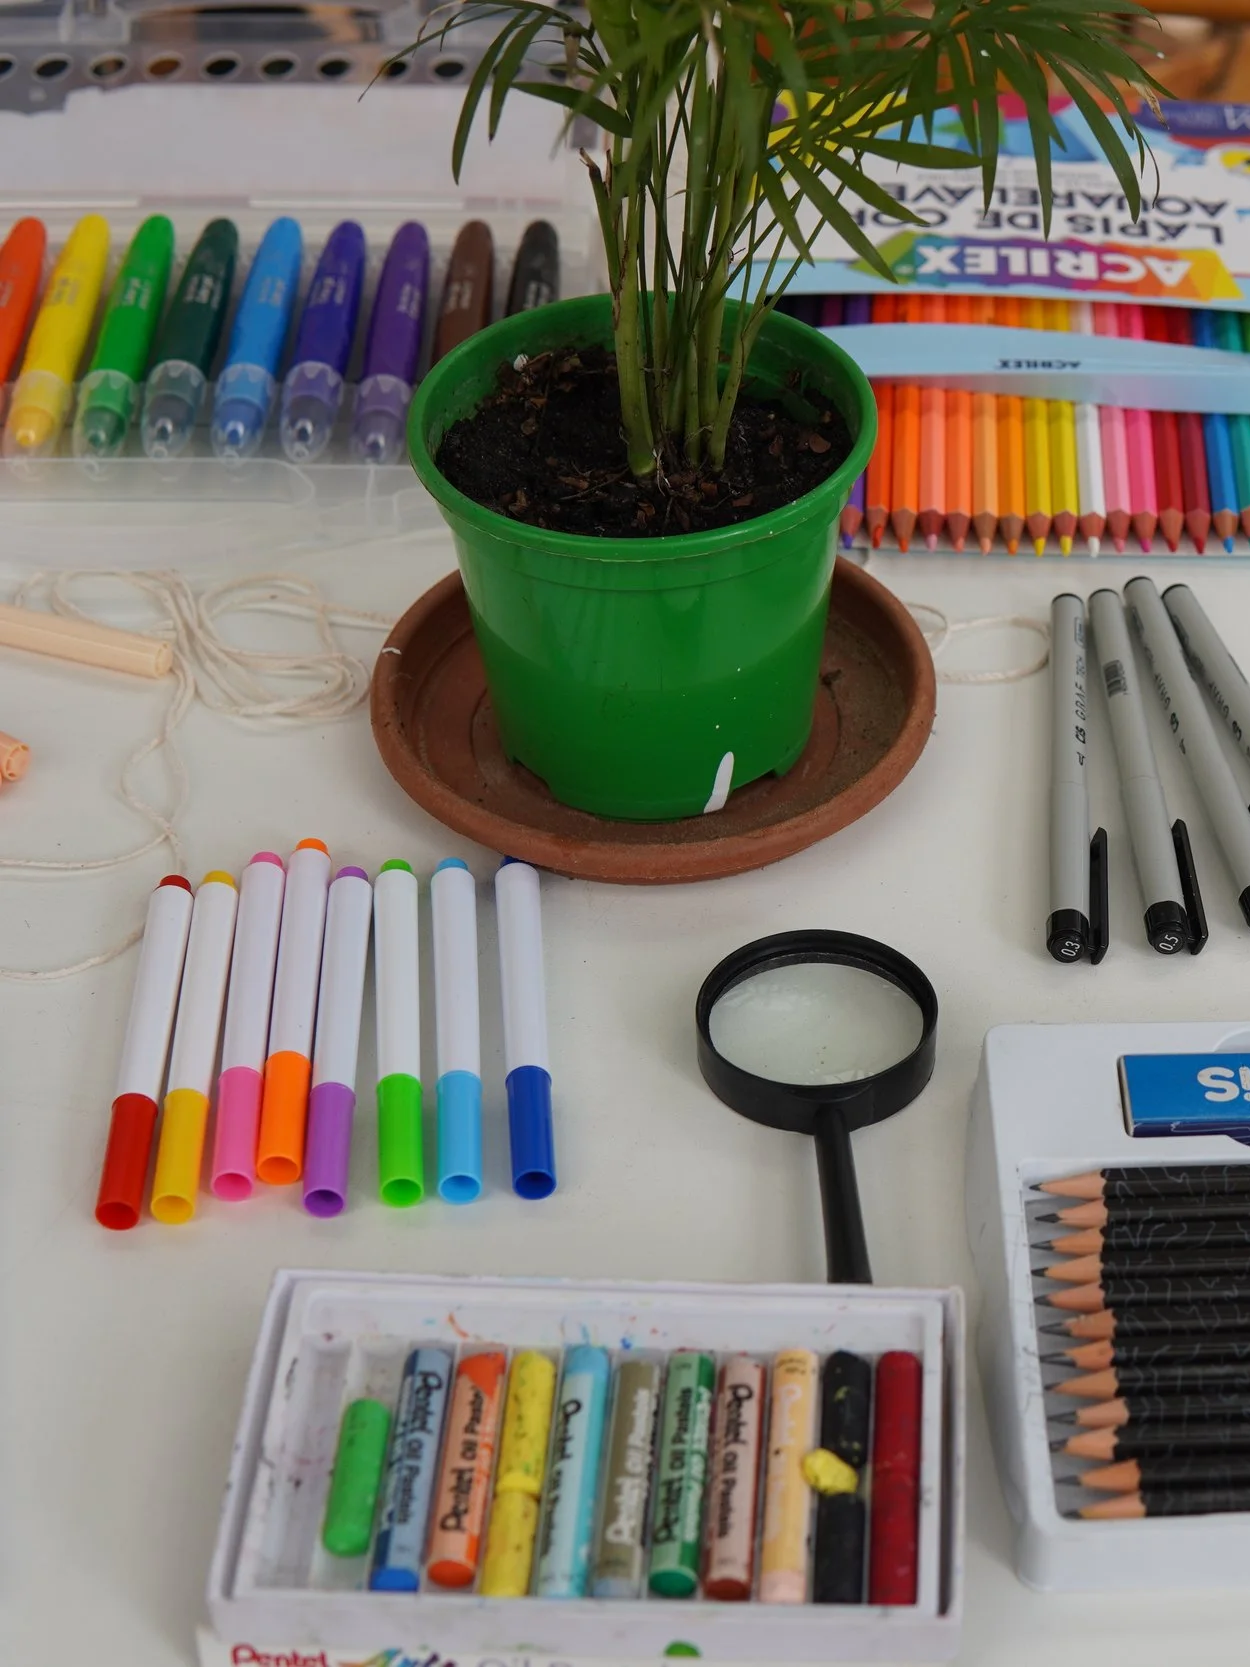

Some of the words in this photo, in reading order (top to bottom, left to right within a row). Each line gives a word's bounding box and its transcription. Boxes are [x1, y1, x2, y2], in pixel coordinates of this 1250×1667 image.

[881, 182, 1227, 219] AQUARELÁVE
[973, 209, 1039, 230] DE
[1066, 213, 1224, 245] LÁPIS
[916, 243, 1193, 287] ACRILEX
[1061, 939, 1081, 957] 0.3
[1158, 933, 1180, 952] 0.5
